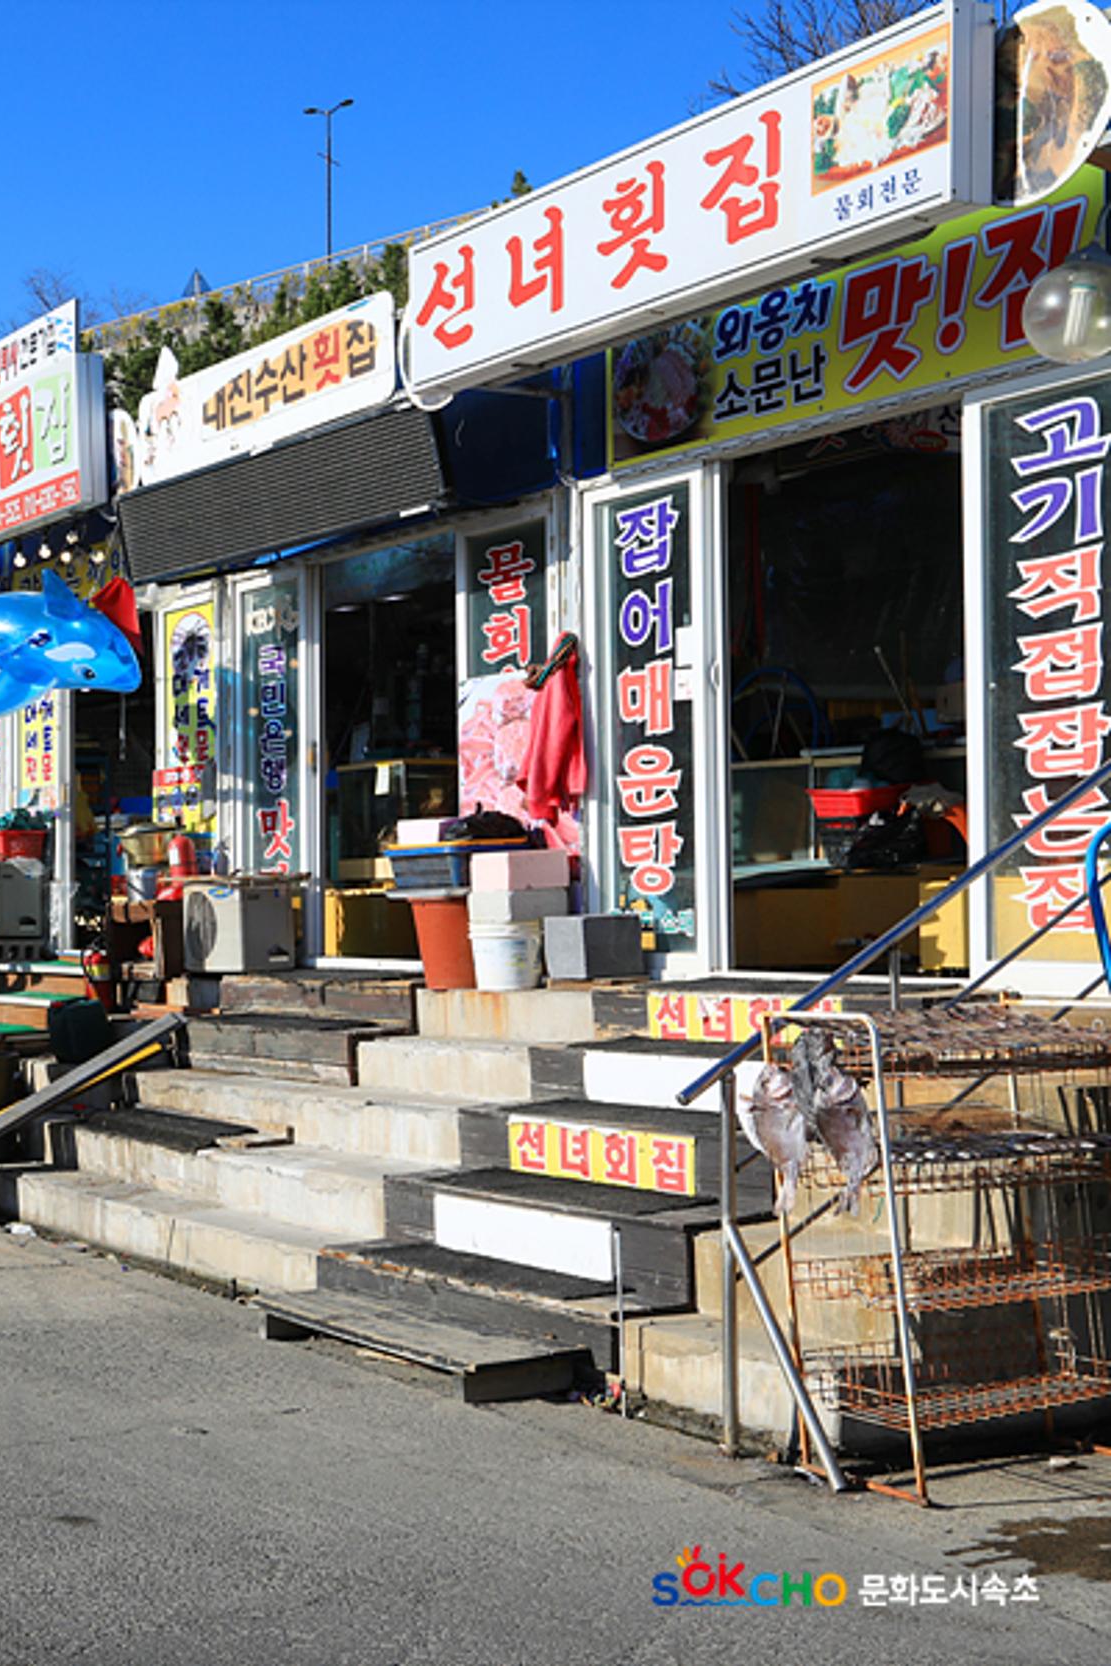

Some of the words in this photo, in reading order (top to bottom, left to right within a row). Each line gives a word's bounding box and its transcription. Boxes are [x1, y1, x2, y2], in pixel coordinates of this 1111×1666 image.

[415, 110, 783, 350] 선녀횟집
[714, 280, 831, 365] 외옹치
[715, 348, 827, 422] 소문난
[479, 542, 535, 666] 물회
[615, 497, 682, 895] 잡어매운탕
[656, 994, 834, 1044] 선녀회
[516, 1122, 687, 1193] 선녀회집
